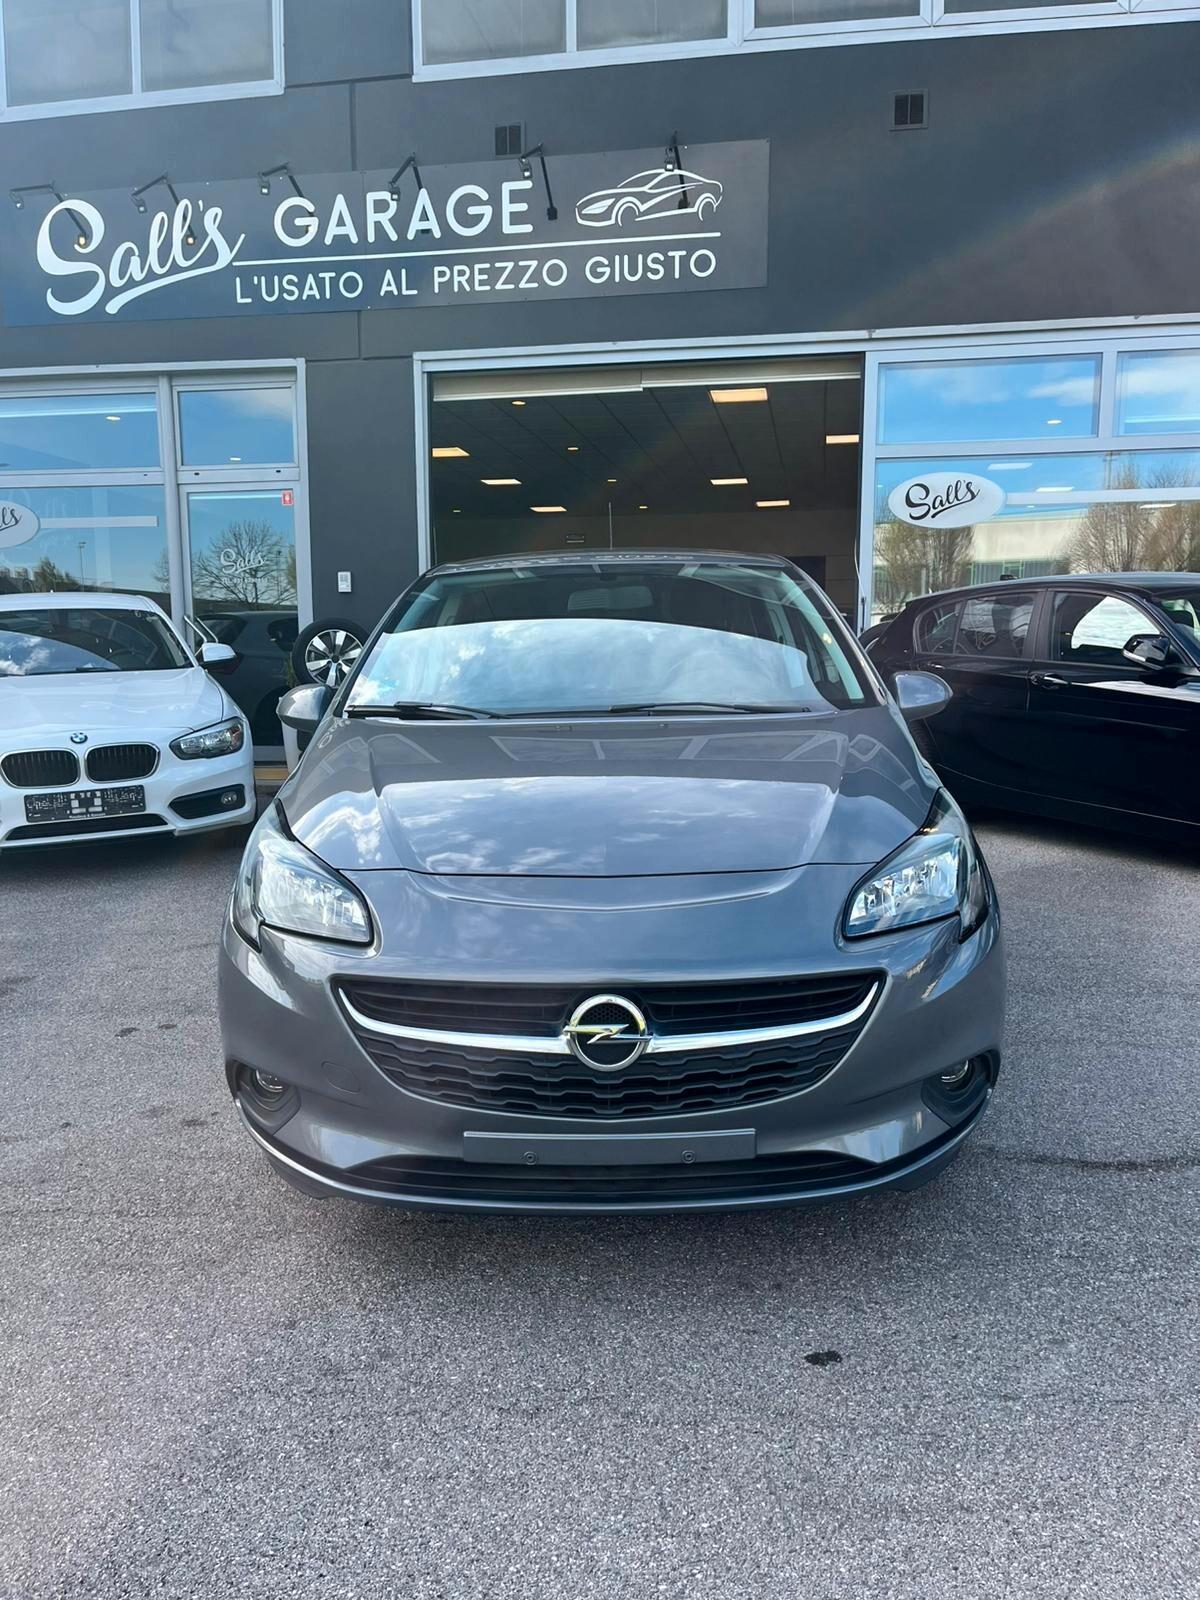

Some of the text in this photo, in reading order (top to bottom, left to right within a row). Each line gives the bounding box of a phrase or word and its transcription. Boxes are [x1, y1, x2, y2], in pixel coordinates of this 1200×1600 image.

[36, 179, 534, 316] Sall's GARAGE
[235, 248, 717, 304] L'USATO AL PREZZO GIUSTO
[905, 479, 981, 521] Sall's
